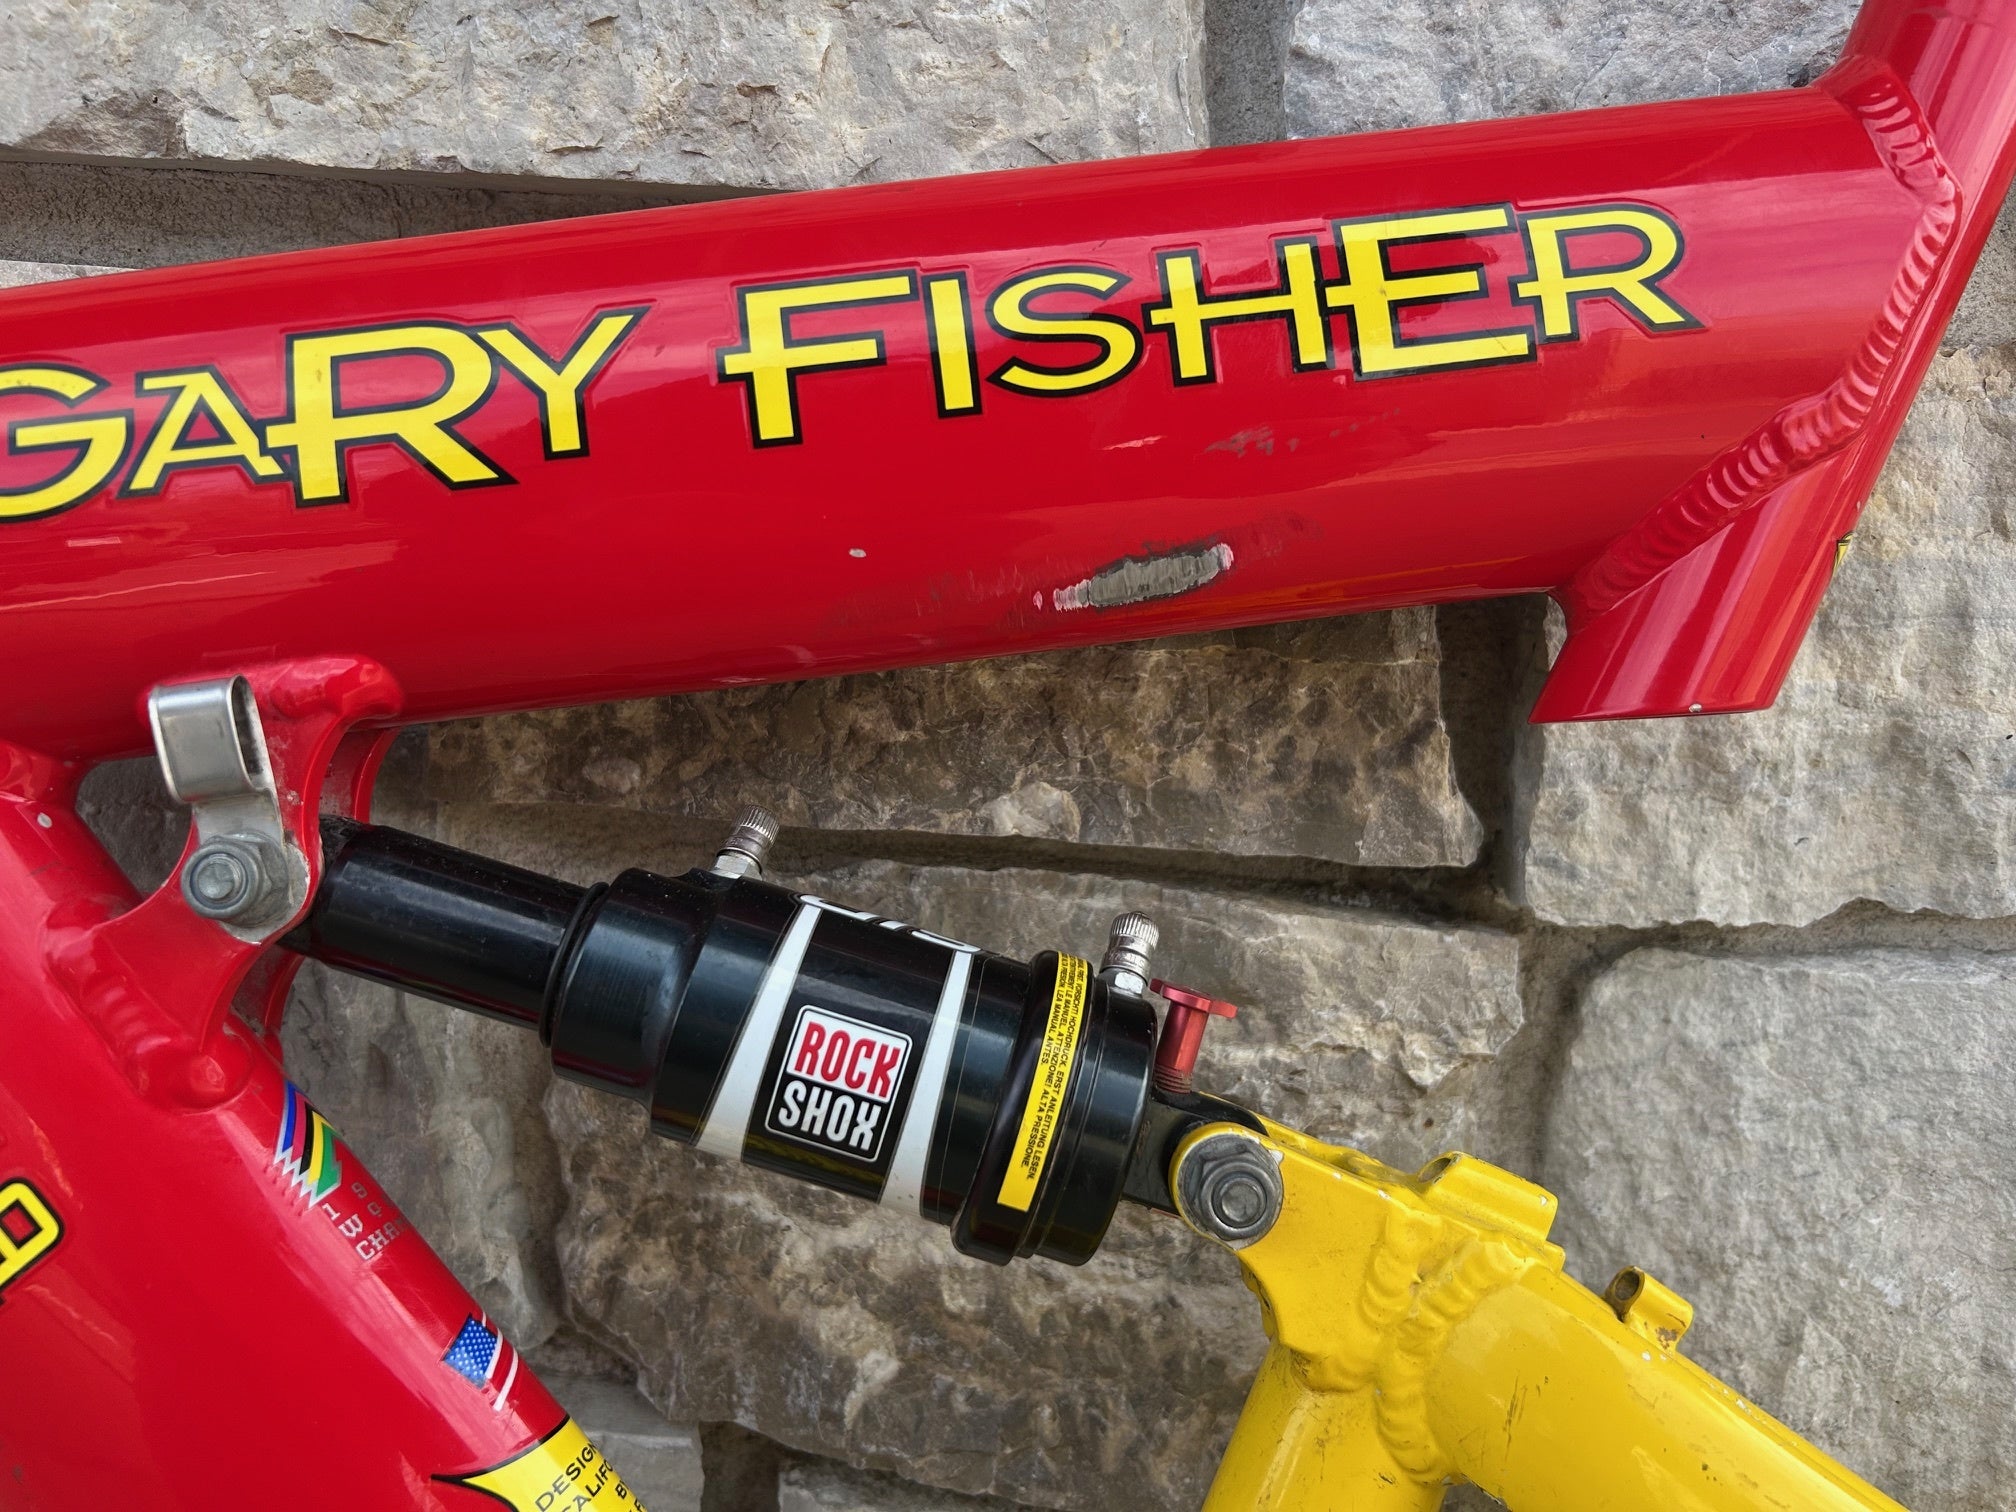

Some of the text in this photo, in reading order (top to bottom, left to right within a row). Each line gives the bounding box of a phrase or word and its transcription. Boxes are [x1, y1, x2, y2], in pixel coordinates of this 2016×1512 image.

[0, 203, 1704, 521] GARY FISHER
[1048, 1003, 1062, 1034] MANUAL
[1058, 1015, 1077, 1067] HOCHDRUCK.
[794, 1021, 901, 1098] ROCK
[1045, 1031, 1065, 1088] ATTENZIONE!
[1053, 1071, 1065, 1095] ERST
[778, 1080, 882, 1151] SHOX
[1037, 1089, 1050, 1113] ALTA
[1037, 1096, 1058, 1148] ANLEITUNG
[1021, 1115, 1042, 1168] PRESSIONE.
[1026, 1149, 1042, 1180] LESEN.
